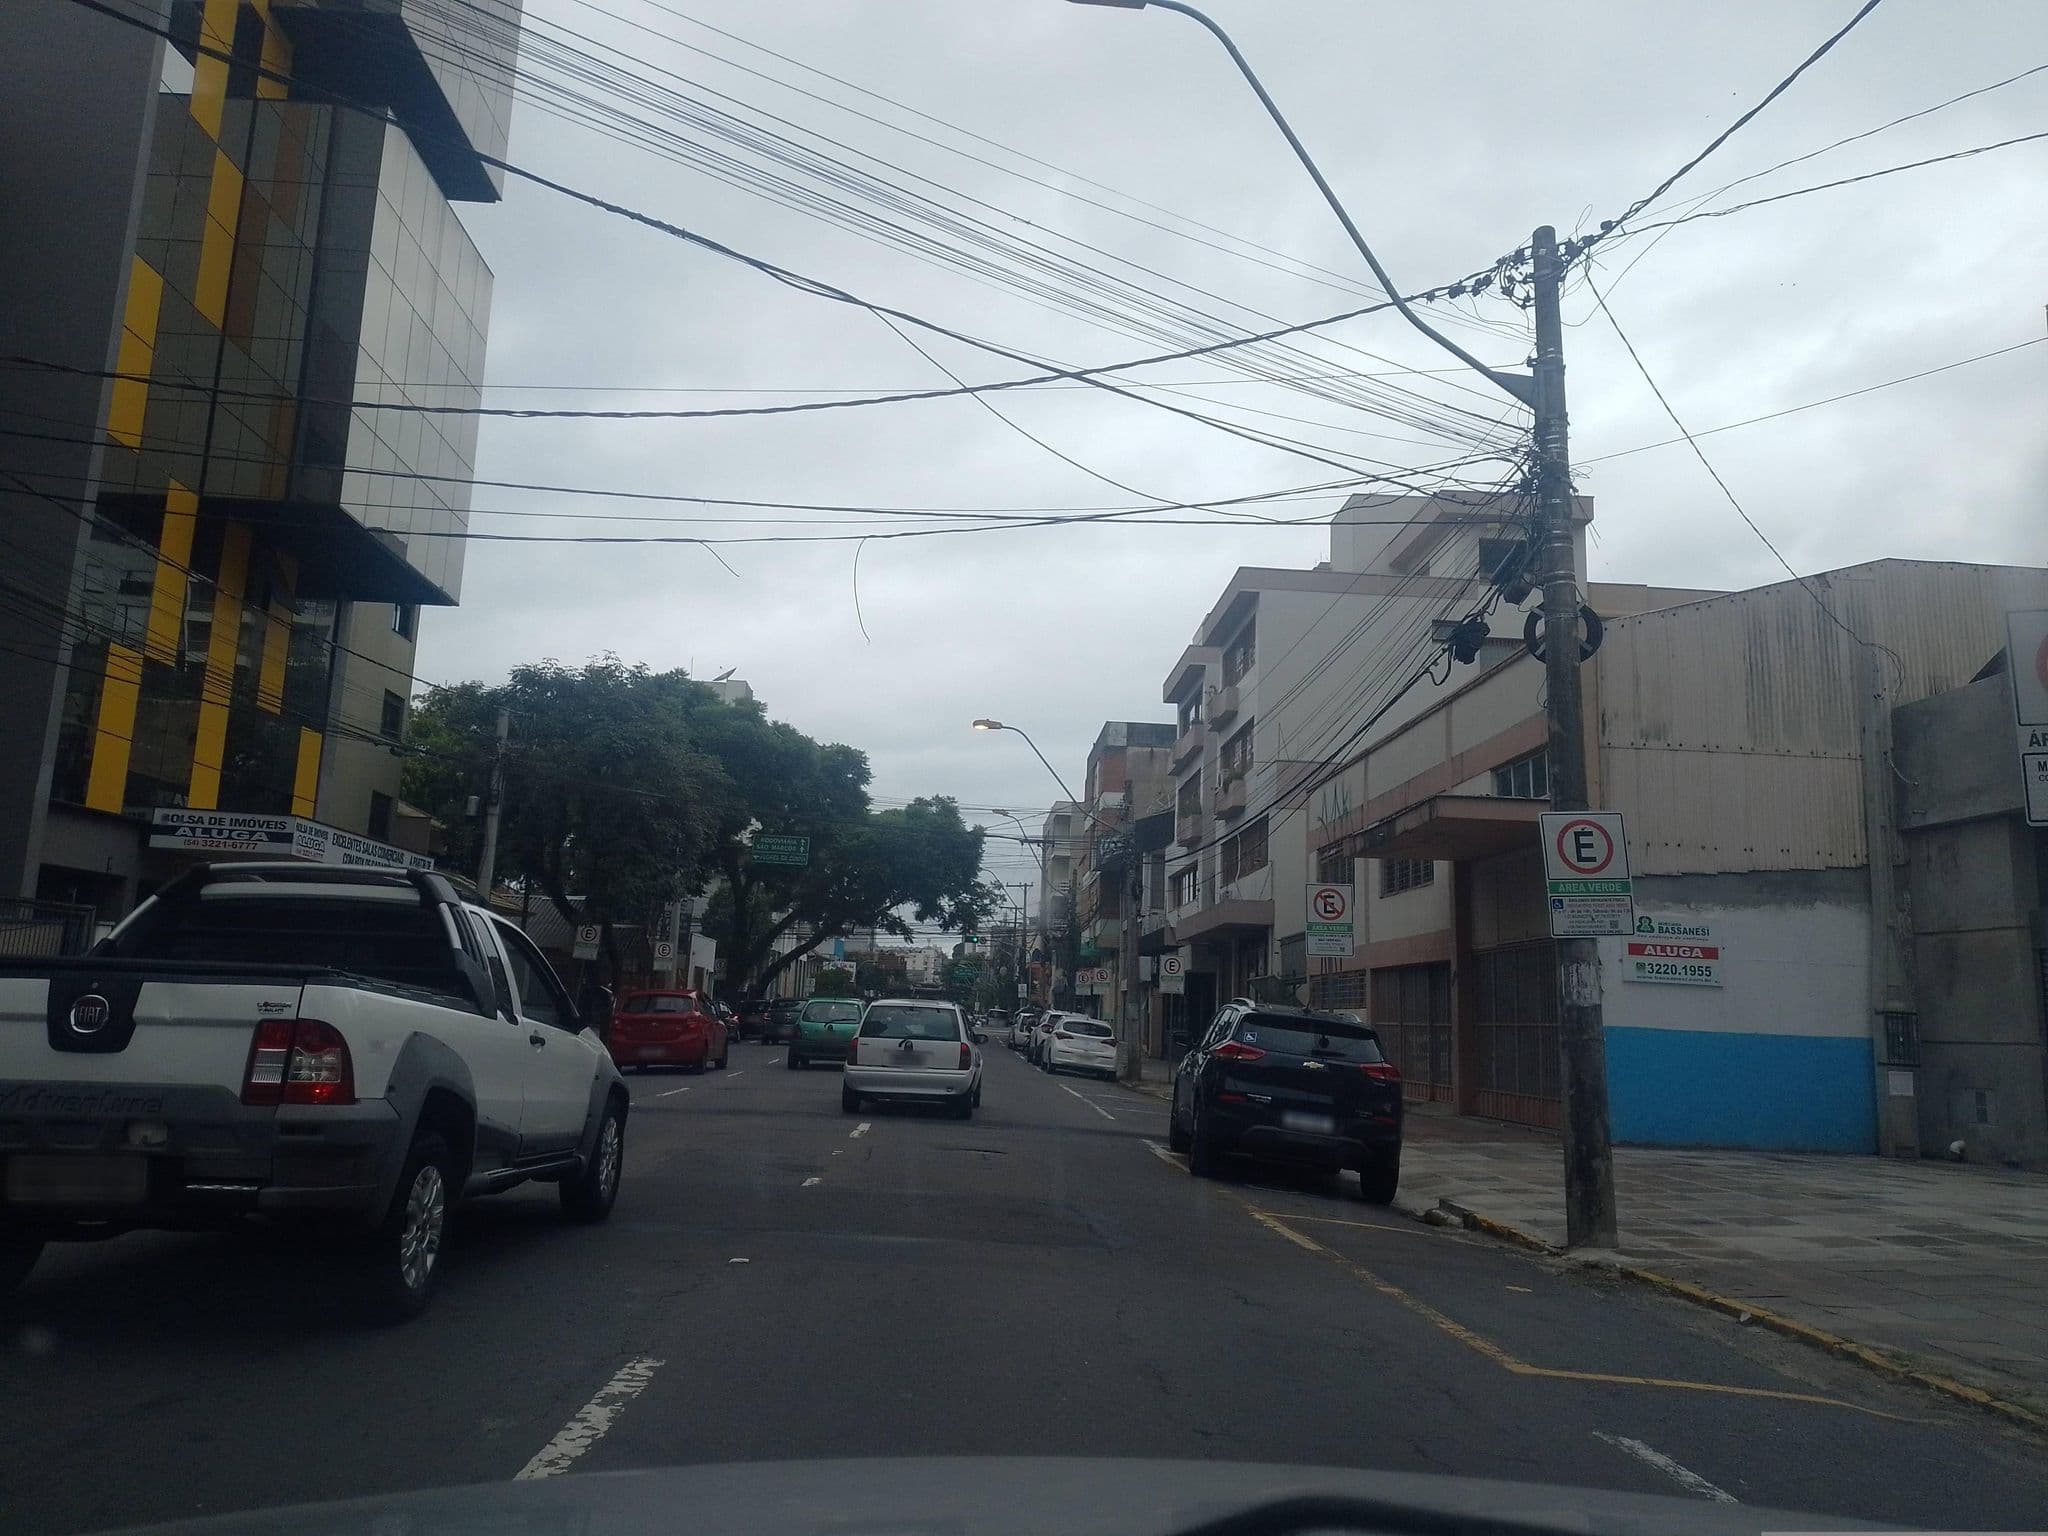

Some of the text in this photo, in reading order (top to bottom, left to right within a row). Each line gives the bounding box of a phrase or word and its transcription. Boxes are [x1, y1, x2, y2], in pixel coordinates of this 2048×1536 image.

[161, 813, 288, 831] BOLSA DE IMÓVEIS
[174, 826, 270, 842] ALUGA
[183, 839, 258, 851] (54) 3221-6777
[297, 834, 326, 853] ALUGA
[332, 832, 362, 853] EXCELENTES
[362, 841, 378, 858] SALAS
[378, 845, 405, 865] COMERCIAIS
[1573, 830, 1597, 862] E
[1587, 882, 1622, 893] VERDE
[1323, 895, 1335, 914] E
[585, 928, 593, 939] E
[1657, 925, 1710, 937] BASSANESI
[1643, 945, 1704, 958] ALUGA
[1169, 961, 1176, 971] E
[1647, 962, 1712, 977] 3220.1955
[77, 1005, 103, 1023] FIAT
